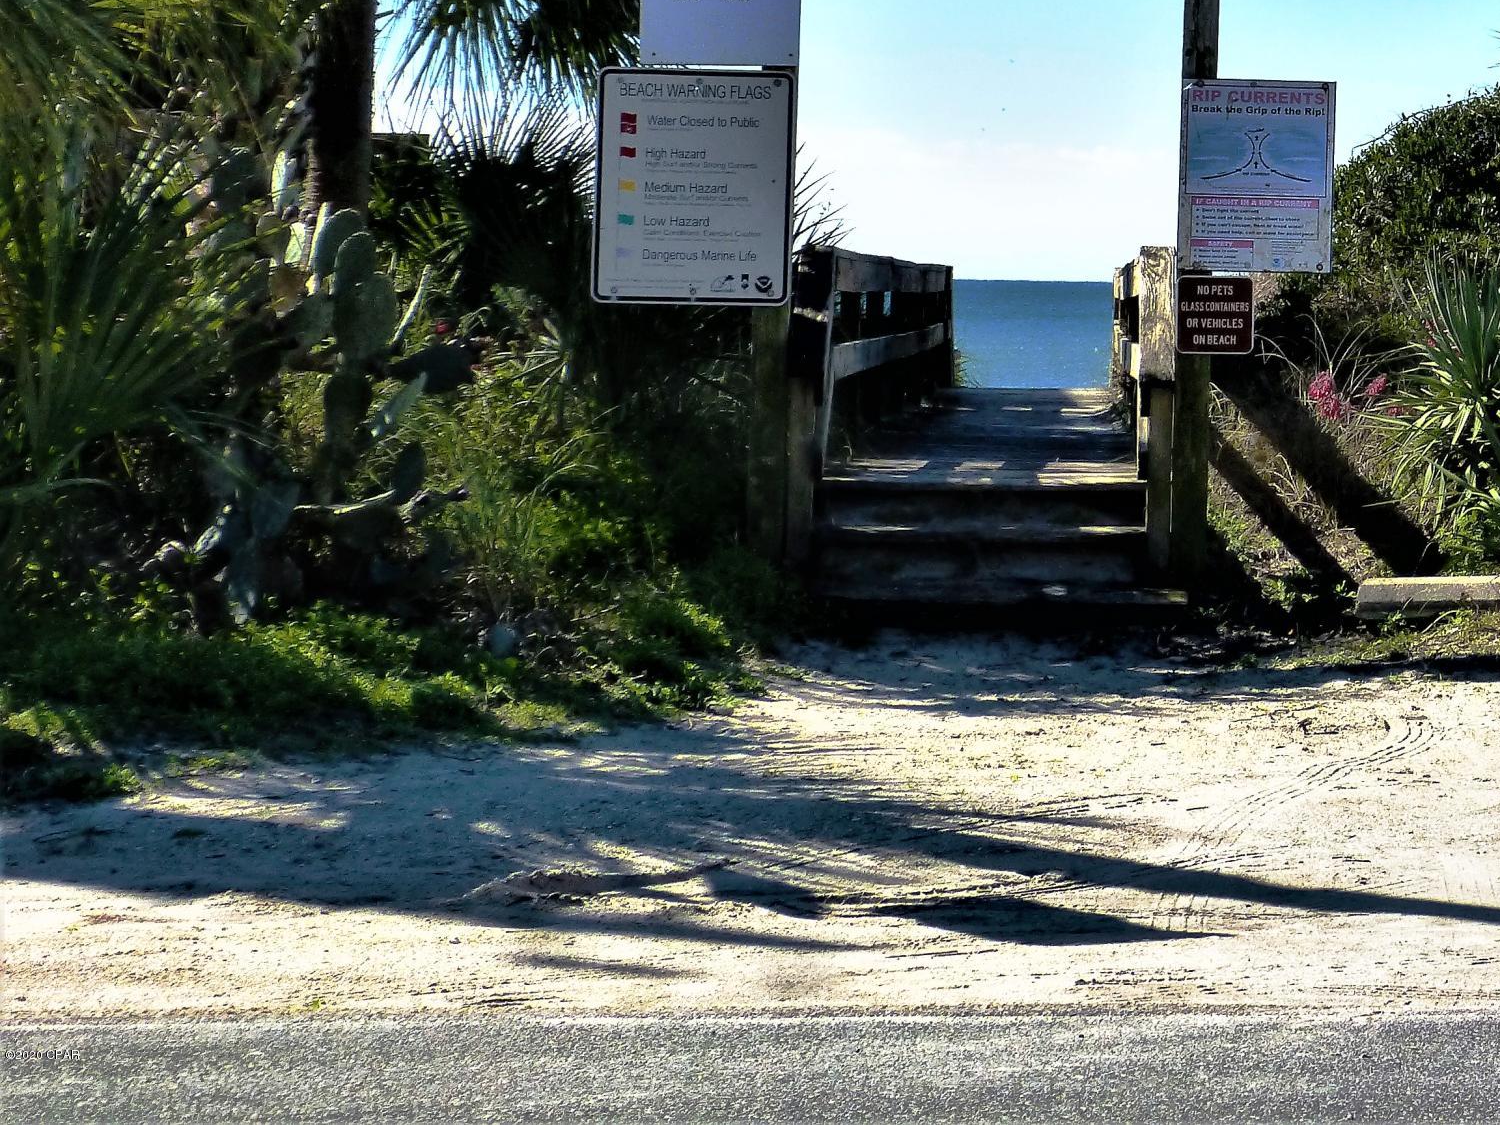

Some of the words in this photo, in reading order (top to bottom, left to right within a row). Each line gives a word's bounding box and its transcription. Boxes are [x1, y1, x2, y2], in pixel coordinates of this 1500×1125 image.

[619, 82, 663, 97] BEACH
[667, 83, 726, 99] WARNING
[730, 85, 772, 99] FLAGS
[1192, 89, 1221, 102] RIP
[1228, 90, 1326, 105] CURRENTS
[1191, 104, 1222, 113] Break
[1226, 104, 1242, 114] the
[1246, 106, 1268, 116] Grip
[1271, 107, 1281, 115] of
[1284, 107, 1301, 116] the
[1305, 107, 1325, 117] Rip!
[647, 115, 677, 126] Water
[679, 115, 715, 128] Closed
[718, 116, 727, 128] to
[731, 117, 760, 129] Public
[645, 148, 667, 161] High
[670, 149, 706, 159] Hazard
[645, 182, 686, 193] Medium
[689, 183, 728, 194] Hazard
[643, 216, 666, 226] Low
[670, 216, 710, 227] Hazard
[642, 249, 698, 262] Dangerous
[701, 250, 736, 261] Marine
[738, 251, 757, 261] Life
[1197, 285, 1209, 295] NO
[1211, 285, 1233, 295] PETS
[1180, 301, 1204, 312] GLASS
[1205, 301, 1249, 312] CONTAINERS
[1186, 318, 1198, 328] OR
[1200, 318, 1243, 328] VEHICLES
[1193, 335, 1205, 345] ON
[1207, 335, 1237, 345] BEACH
